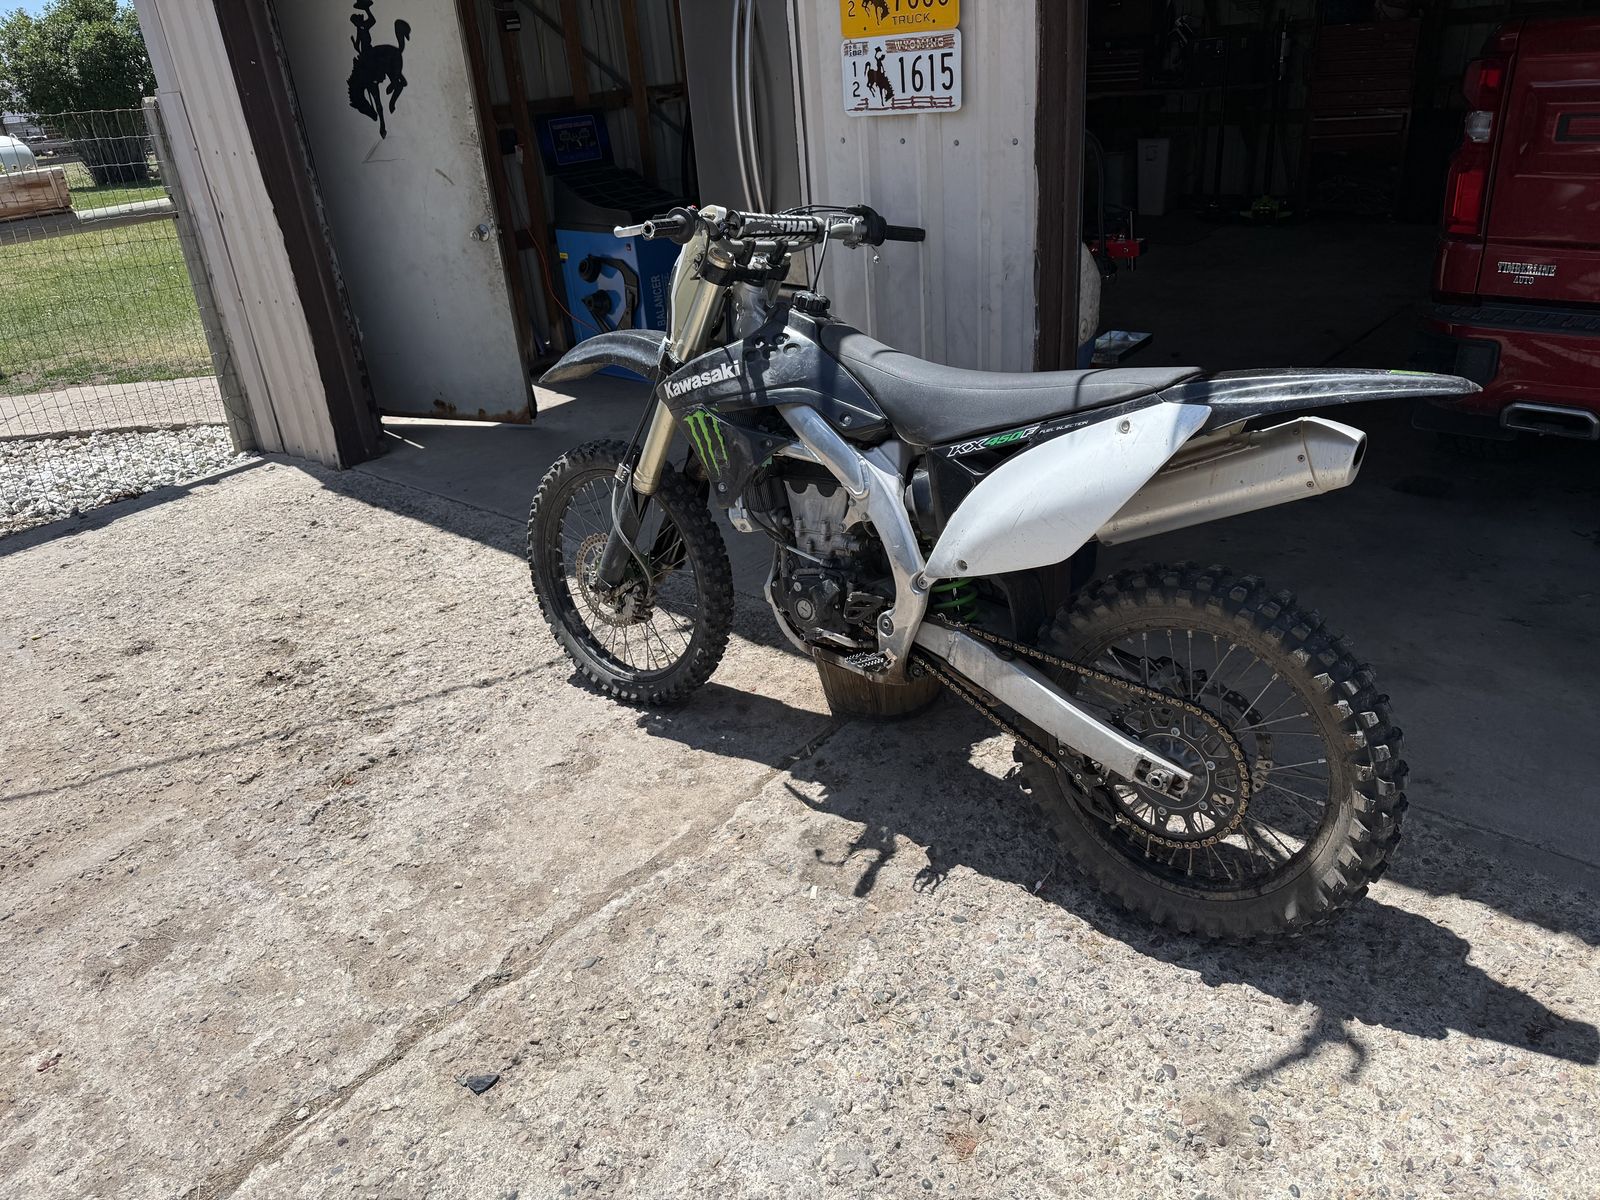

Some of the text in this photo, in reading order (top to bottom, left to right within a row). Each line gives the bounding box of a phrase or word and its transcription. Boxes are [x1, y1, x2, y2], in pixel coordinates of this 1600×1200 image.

[848, 1, 856, 17] 2
[891, 13, 931, 25] TRUCK
[895, 38, 944, 50] WYOMING
[898, 52, 954, 93] 1615
[852, 81, 861, 97] 2
[1497, 262, 1556, 276] TIMBERLINE
[1513, 275, 1535, 285] AUTO
[651, 274, 666, 327] BALANCER
[664, 359, 741, 399] Kawasaki
[946, 425, 1040, 457] KX450F
[1056, 420, 1089, 431] INJECTION
